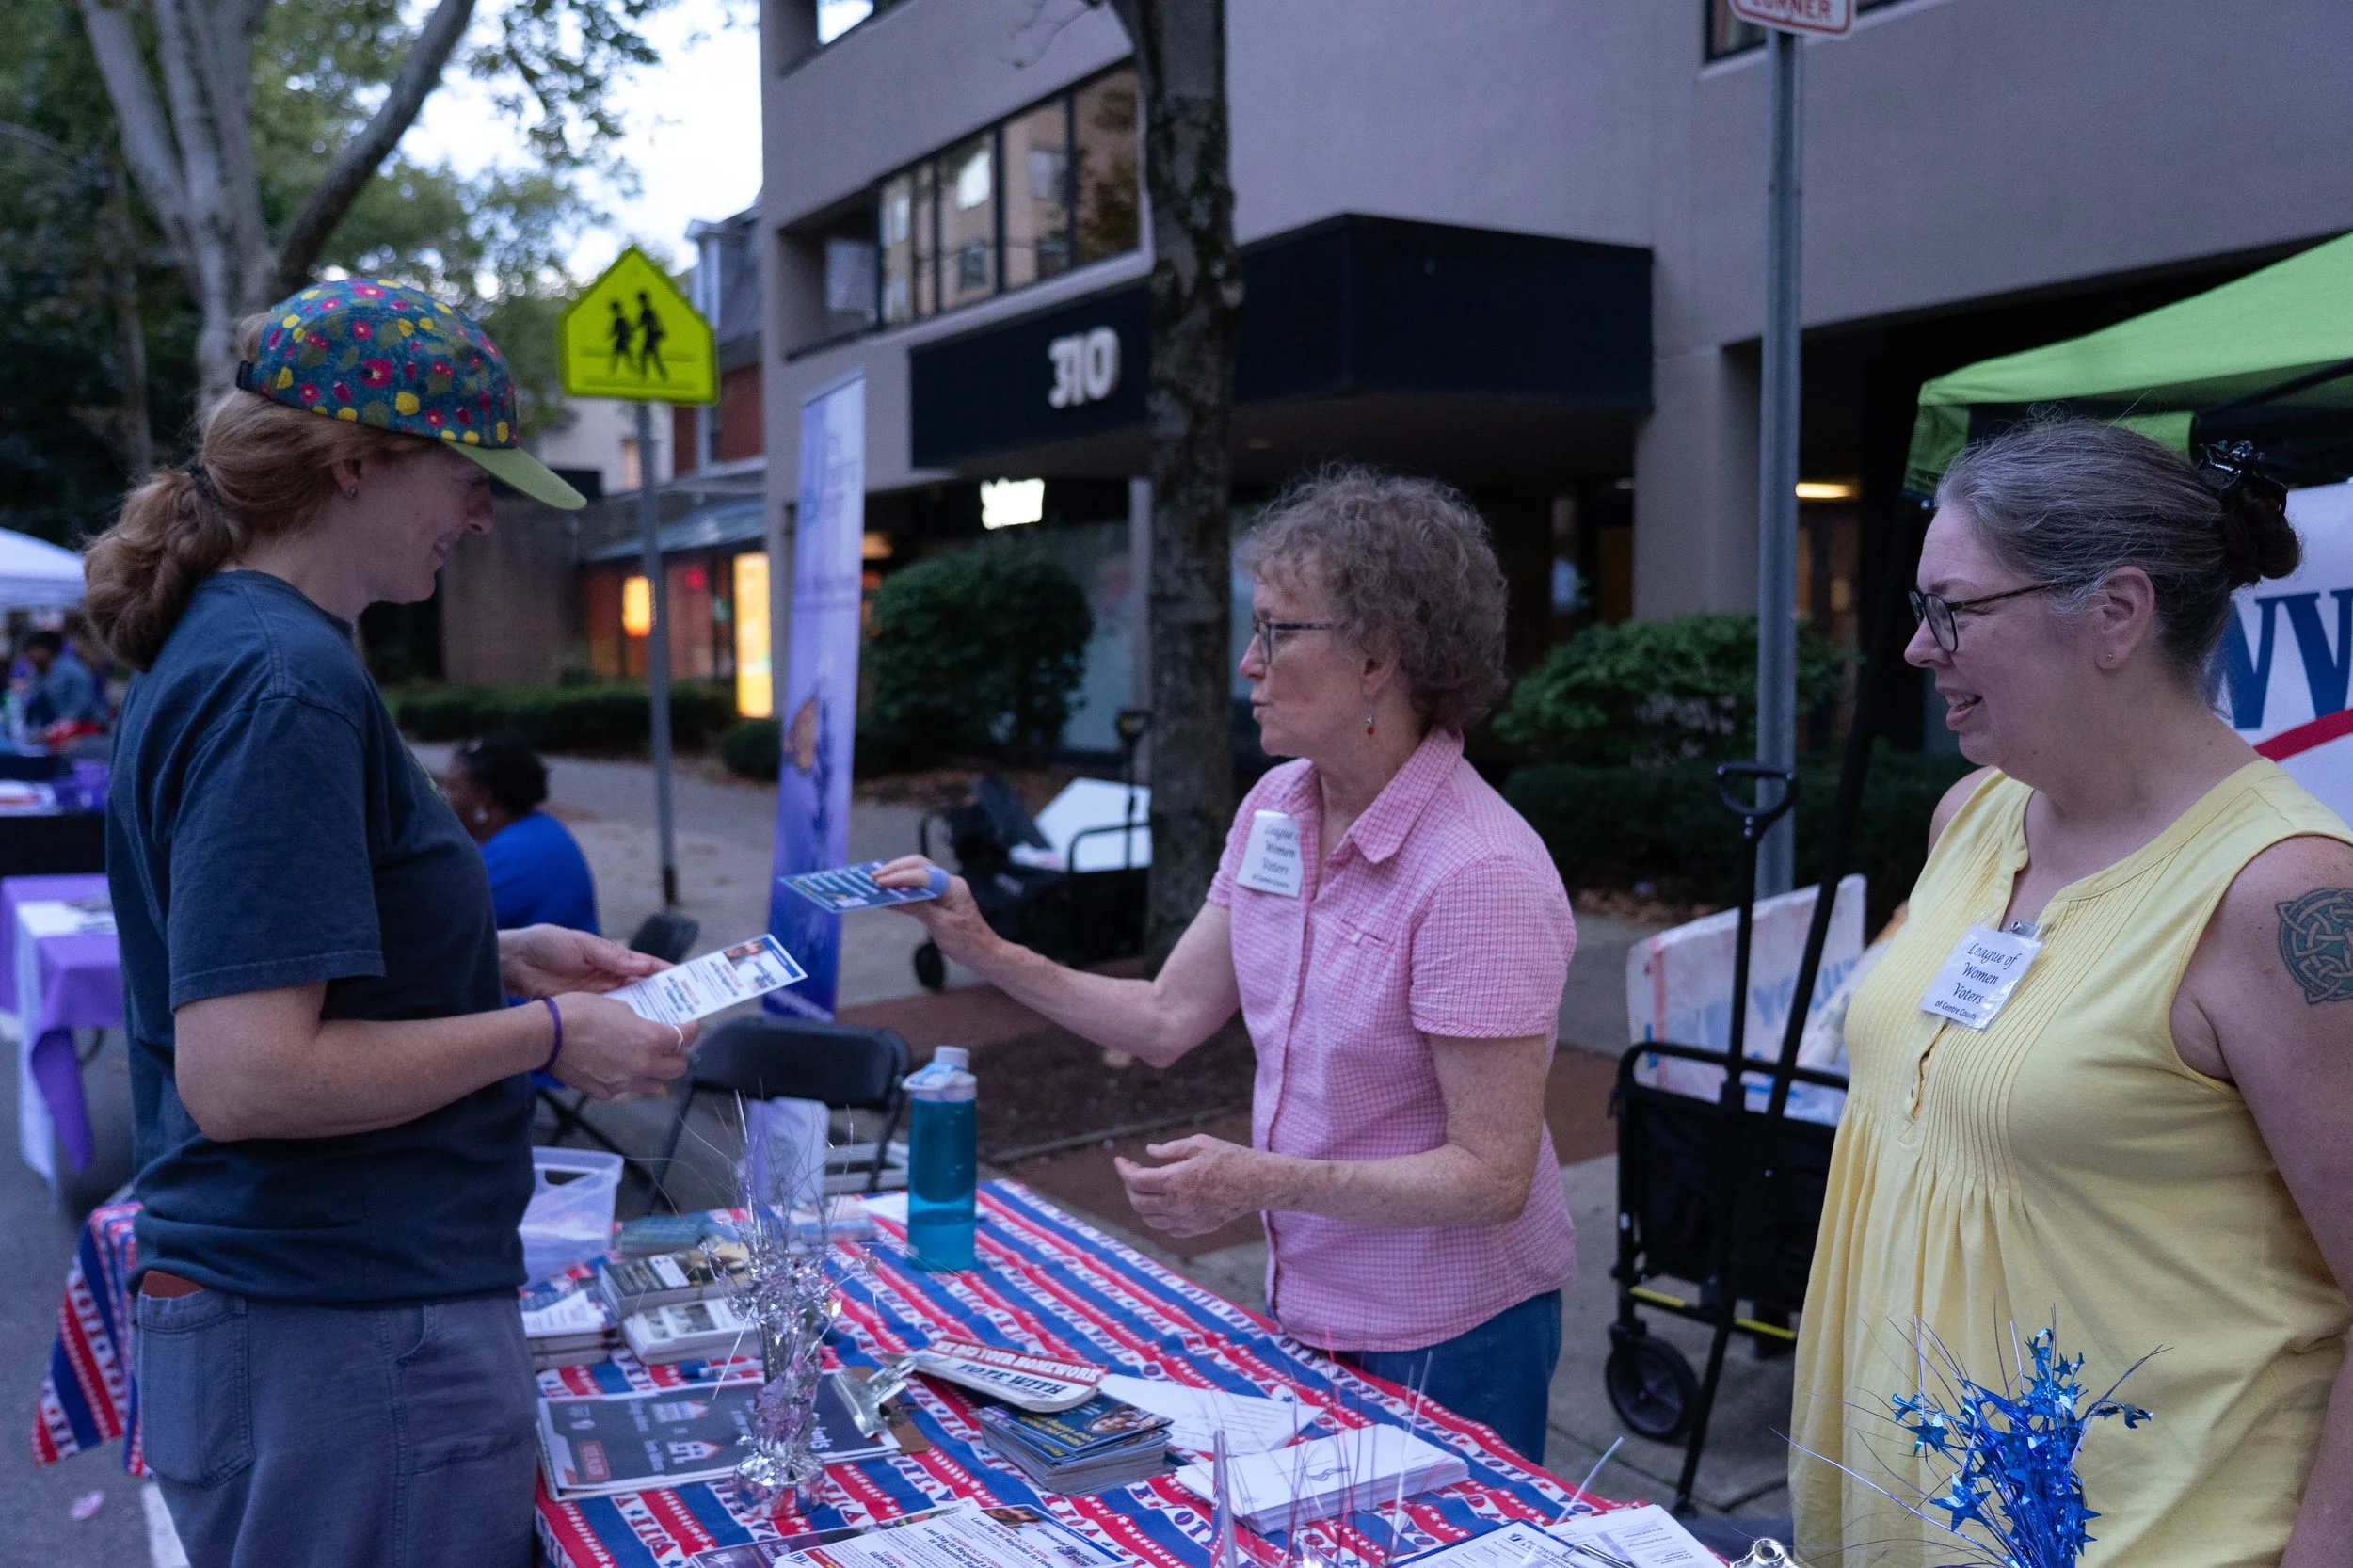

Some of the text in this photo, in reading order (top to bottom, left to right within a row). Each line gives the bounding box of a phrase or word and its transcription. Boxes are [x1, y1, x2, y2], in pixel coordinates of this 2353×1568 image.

[1047, 325, 1121, 408] 310
[1967, 942, 2022, 970] League of
[1962, 962, 1998, 985] Women
[1953, 982, 1984, 1004] Voters
[1935, 1000, 1977, 1021] of Centre County
[956, 1363, 1012, 1381] VOTE
[1009, 1375, 1069, 1395] WITH
[979, 1347, 1017, 1364] YOUR
[1014, 1356, 1102, 1383] HOMEWORK
[1473, 1449, 1535, 1481] VOTE
[629, 1517, 677, 1559] VOTE
[923, 1527, 936, 1537] Last
[936, 1532, 949, 1545] Day
[954, 1545, 984, 1567] Request
[936, 1542, 965, 1562] Absentee
[970, 1517, 984, 1528] Last
[984, 1524, 997, 1535] Day
[1003, 1537, 1032, 1557] Register
[1037, 1528, 1069, 1550] General
